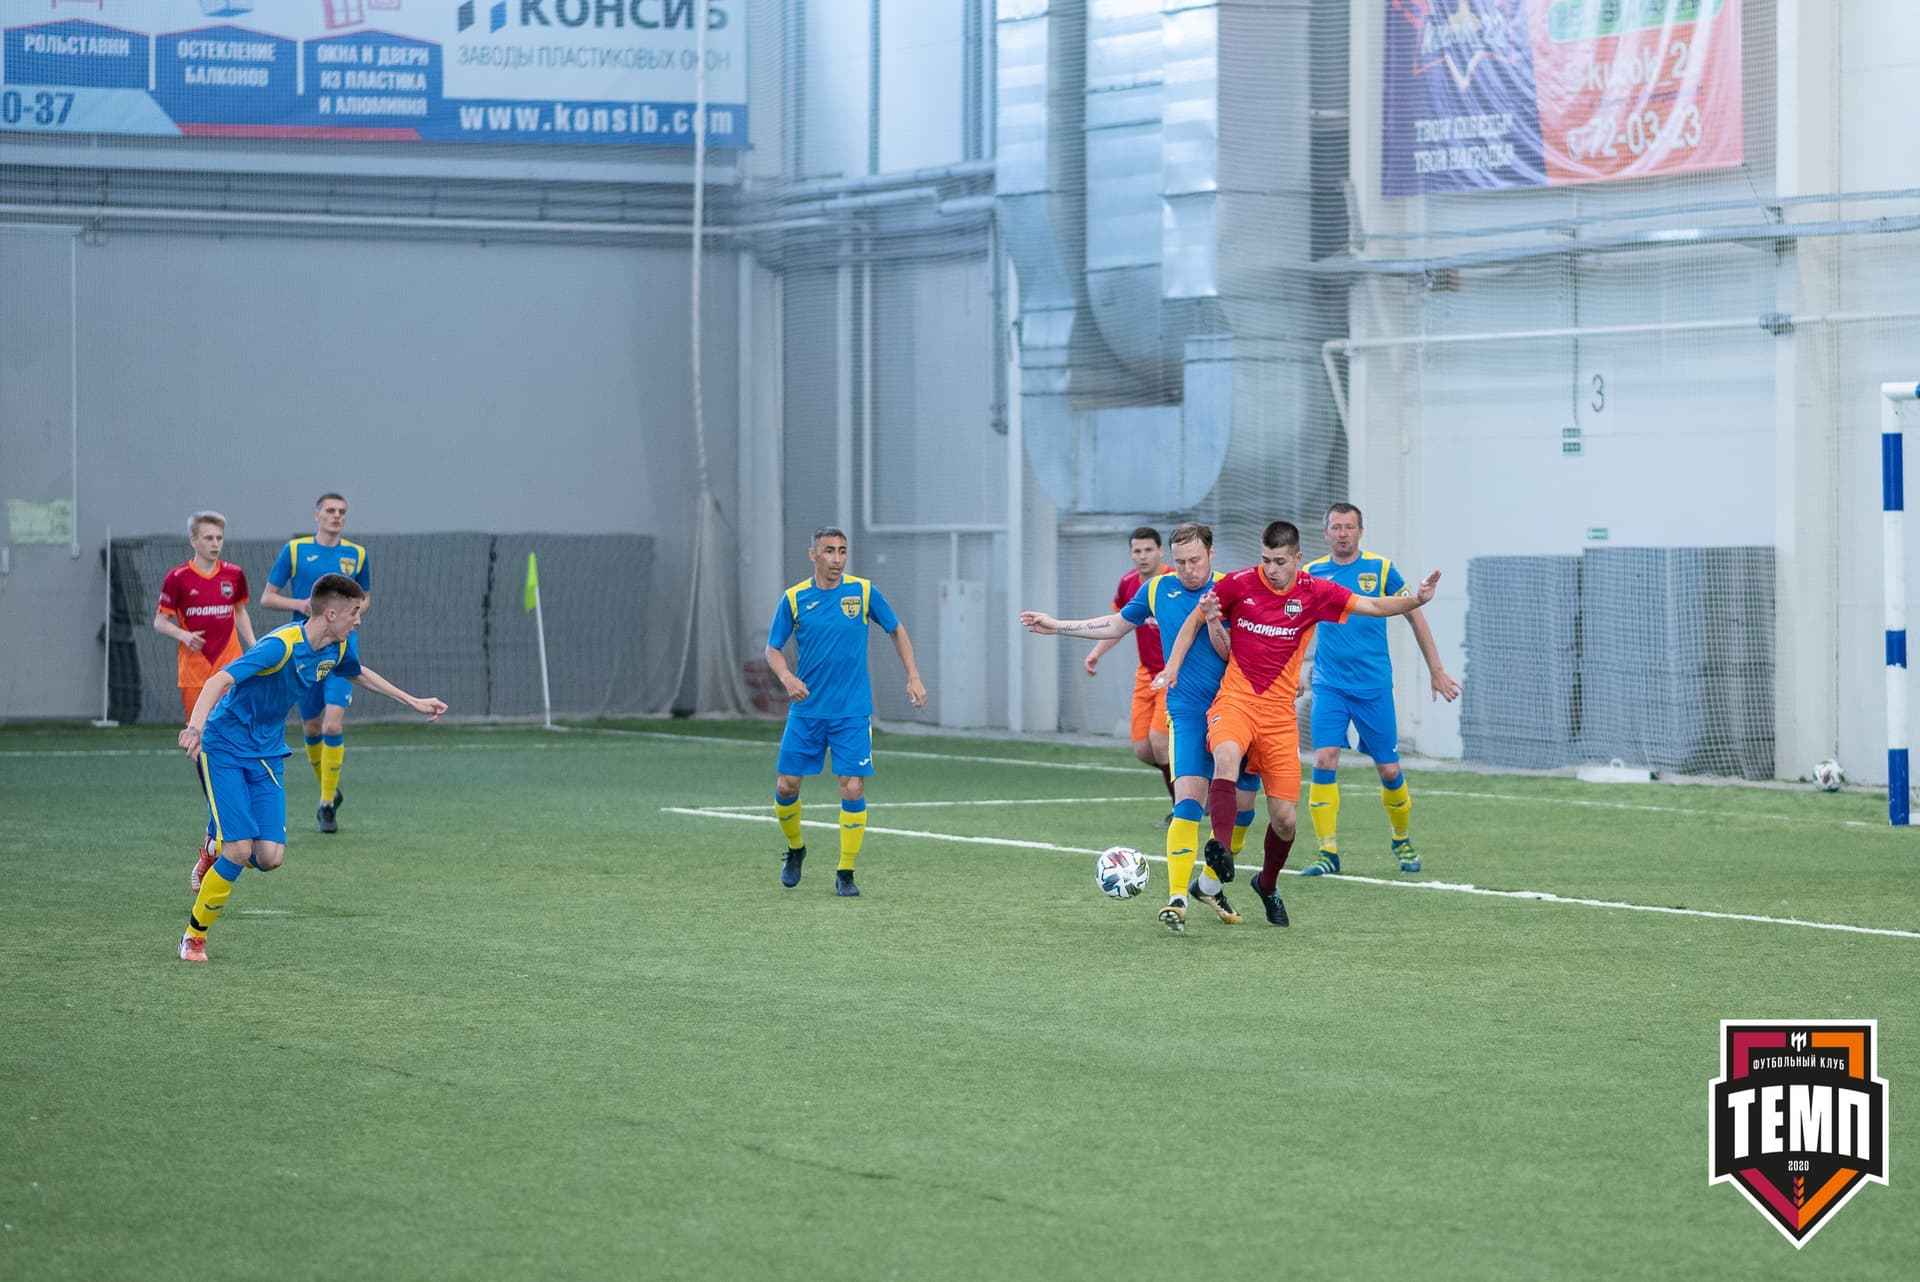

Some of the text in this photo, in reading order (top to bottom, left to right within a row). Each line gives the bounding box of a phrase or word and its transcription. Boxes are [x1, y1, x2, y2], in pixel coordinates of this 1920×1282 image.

[24, 33, 130, 57] РОЛЬСТАВНИ
[177, 39, 276, 63] ОСТЕКЛЕНИЕ
[317, 46, 430, 68] ОКНА И ДВЕРИ
[457, 44, 532, 69] ЗАВОДЫ
[537, 47, 676, 70] ПЛАСТИКОВЫХ
[184, 67, 270, 88] БАЛКОНОВ
[321, 70, 428, 92] ИЗ ПЛАСТИКА
[2, 91, 75, 126] 0-37
[319, 96, 428, 117] И АЛЮМИНИЯ
[1592, 374, 1604, 413] 3
